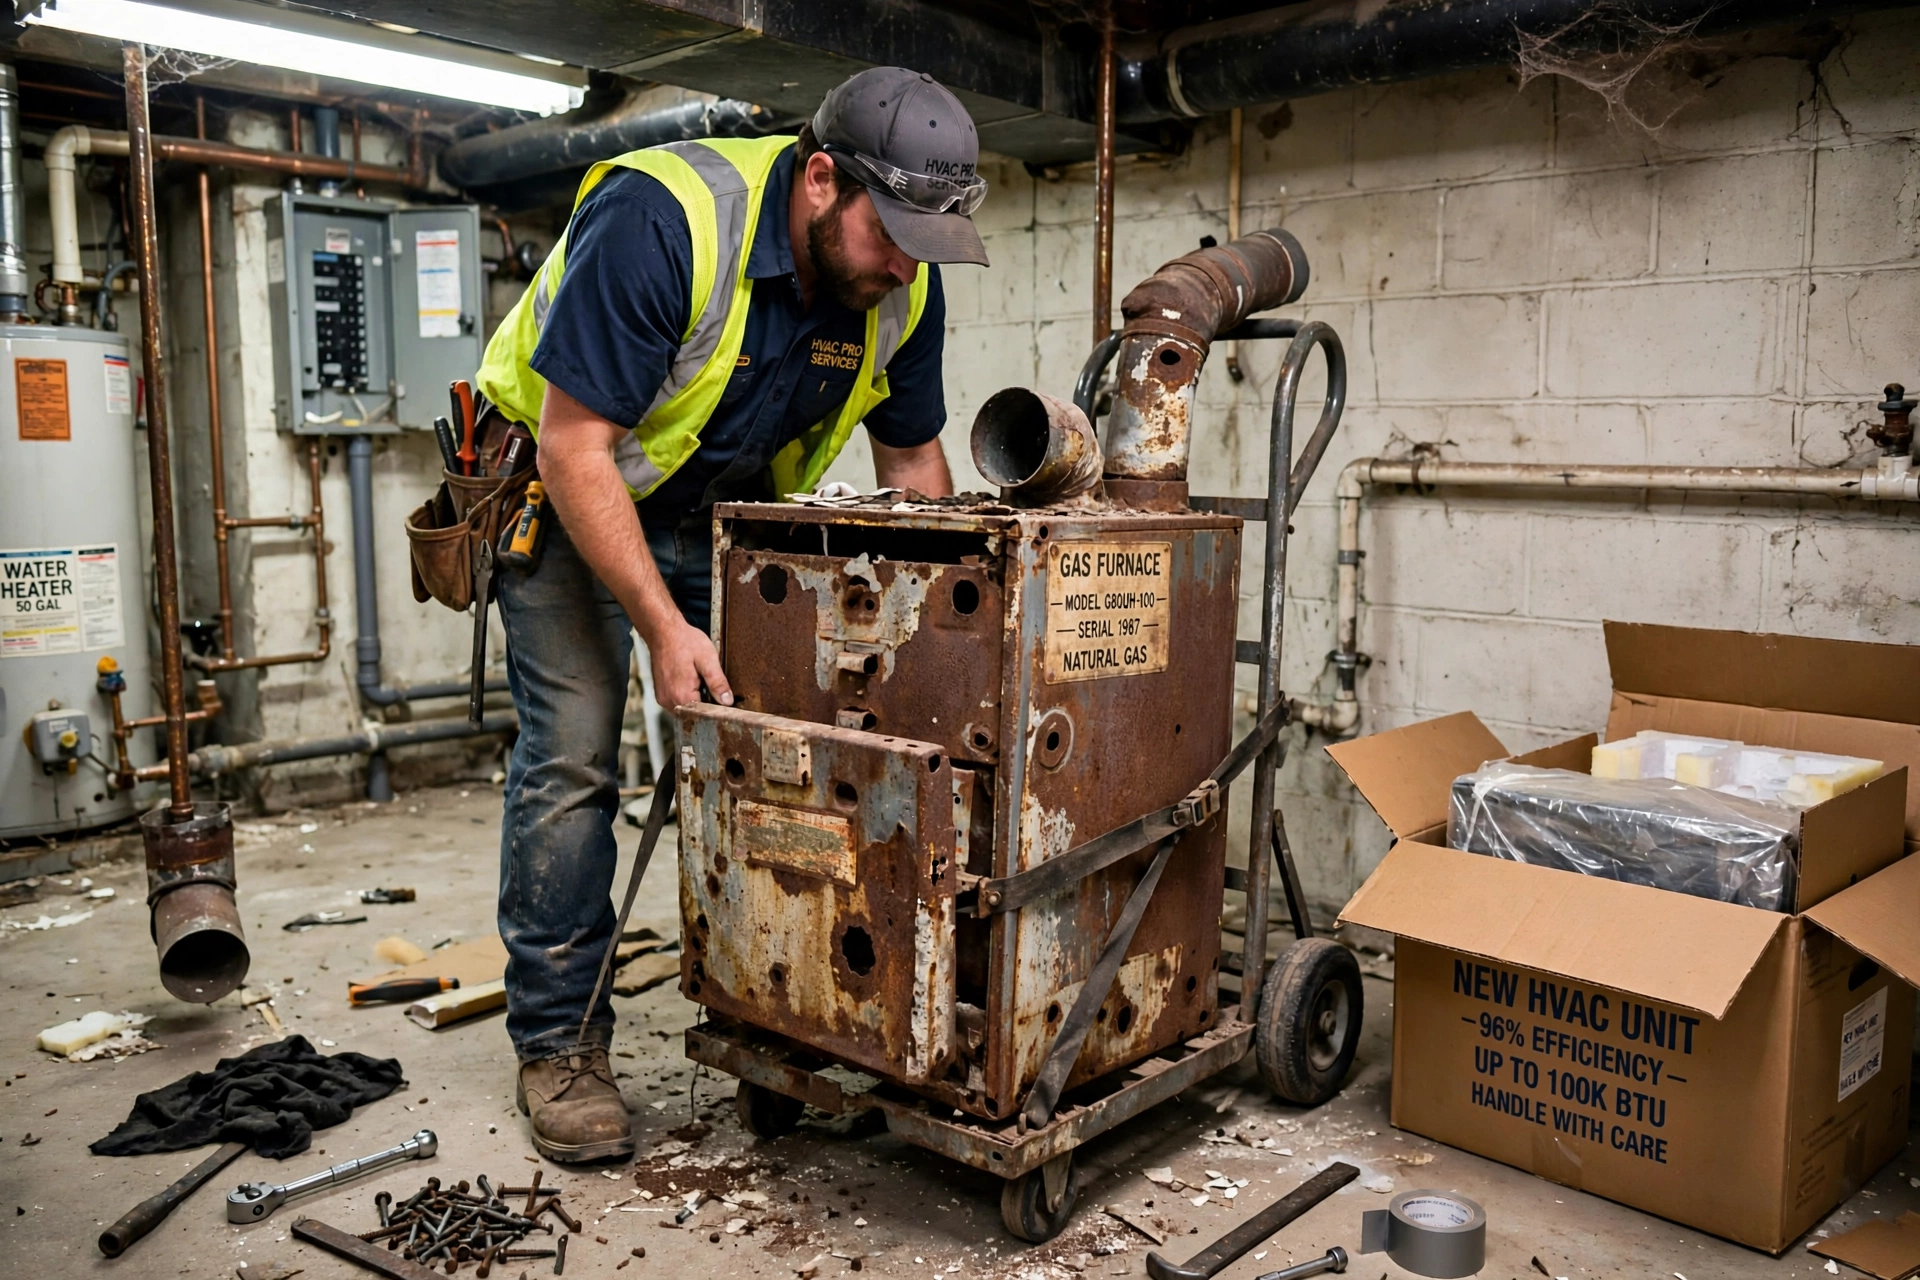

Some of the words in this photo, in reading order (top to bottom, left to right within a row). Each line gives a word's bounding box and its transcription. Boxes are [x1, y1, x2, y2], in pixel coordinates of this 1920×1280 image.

[924, 158, 959, 177] HVAC
[811, 338, 840, 354] HVAC
[841, 342, 863, 357] PRO
[810, 352, 858, 371] SERVICES
[4, 560, 68, 579] WATER
[1060, 552, 1091, 578] GAS
[1097, 552, 1161, 577] FURNACE
[1, 579, 73, 599] HEATER
[16, 600, 32, 612] 50
[36, 598, 62, 612] GAL
[1065, 593, 1101, 611] MODEL
[1078, 619, 1114, 639] SERIAL
[1118, 618, 1141, 636] 1987
[1063, 647, 1120, 672] NATURAL
[1124, 645, 1147, 665] GAS
[1453, 958, 1519, 1008] NEW
[1528, 977, 1610, 1032] HVAC
[1621, 1001, 1700, 1055] UNIT
[1474, 1045, 1503, 1077] UP
[1510, 1056, 1539, 1089] TO
[1547, 1068, 1607, 1111] 100K
[1615, 1087, 1666, 1128] BTU
[1471, 1081, 1547, 1126] HANDLE
[1552, 1106, 1604, 1144] WITH
[1610, 1125, 1668, 1165] CARE
